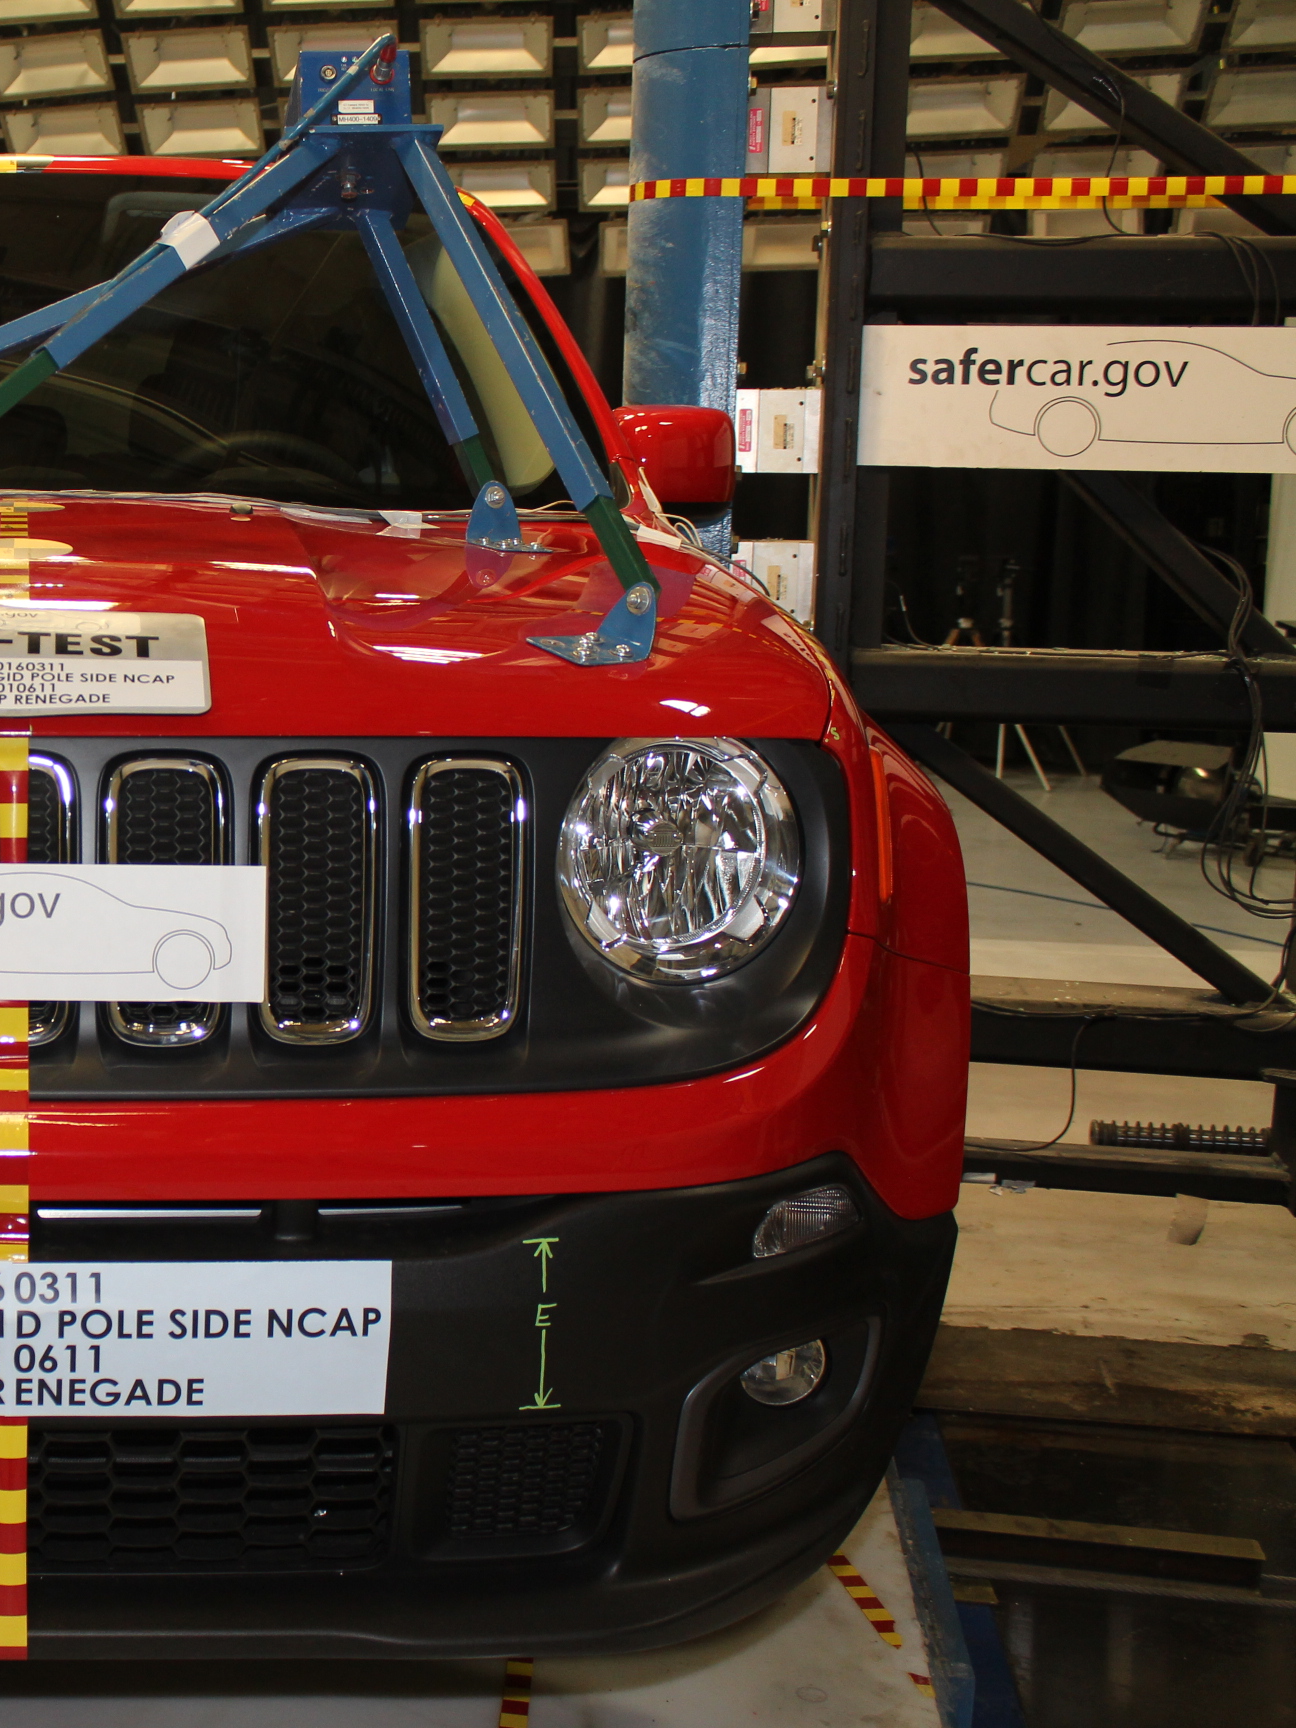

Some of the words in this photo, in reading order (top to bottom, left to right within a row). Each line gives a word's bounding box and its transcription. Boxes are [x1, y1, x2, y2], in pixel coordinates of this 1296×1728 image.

[908, 347, 1190, 398] safercar.gov
[31, 672, 74, 682] POLE
[80, 672, 117, 683] SIDE
[123, 674, 175, 684] NCAP
[14, 693, 111, 705] RENEGADE
[58, 1308, 154, 1340] POLE
[168, 1308, 252, 1340] SIDE
[267, 1307, 382, 1338] NCAP
[535, 1303, 557, 1326] E
